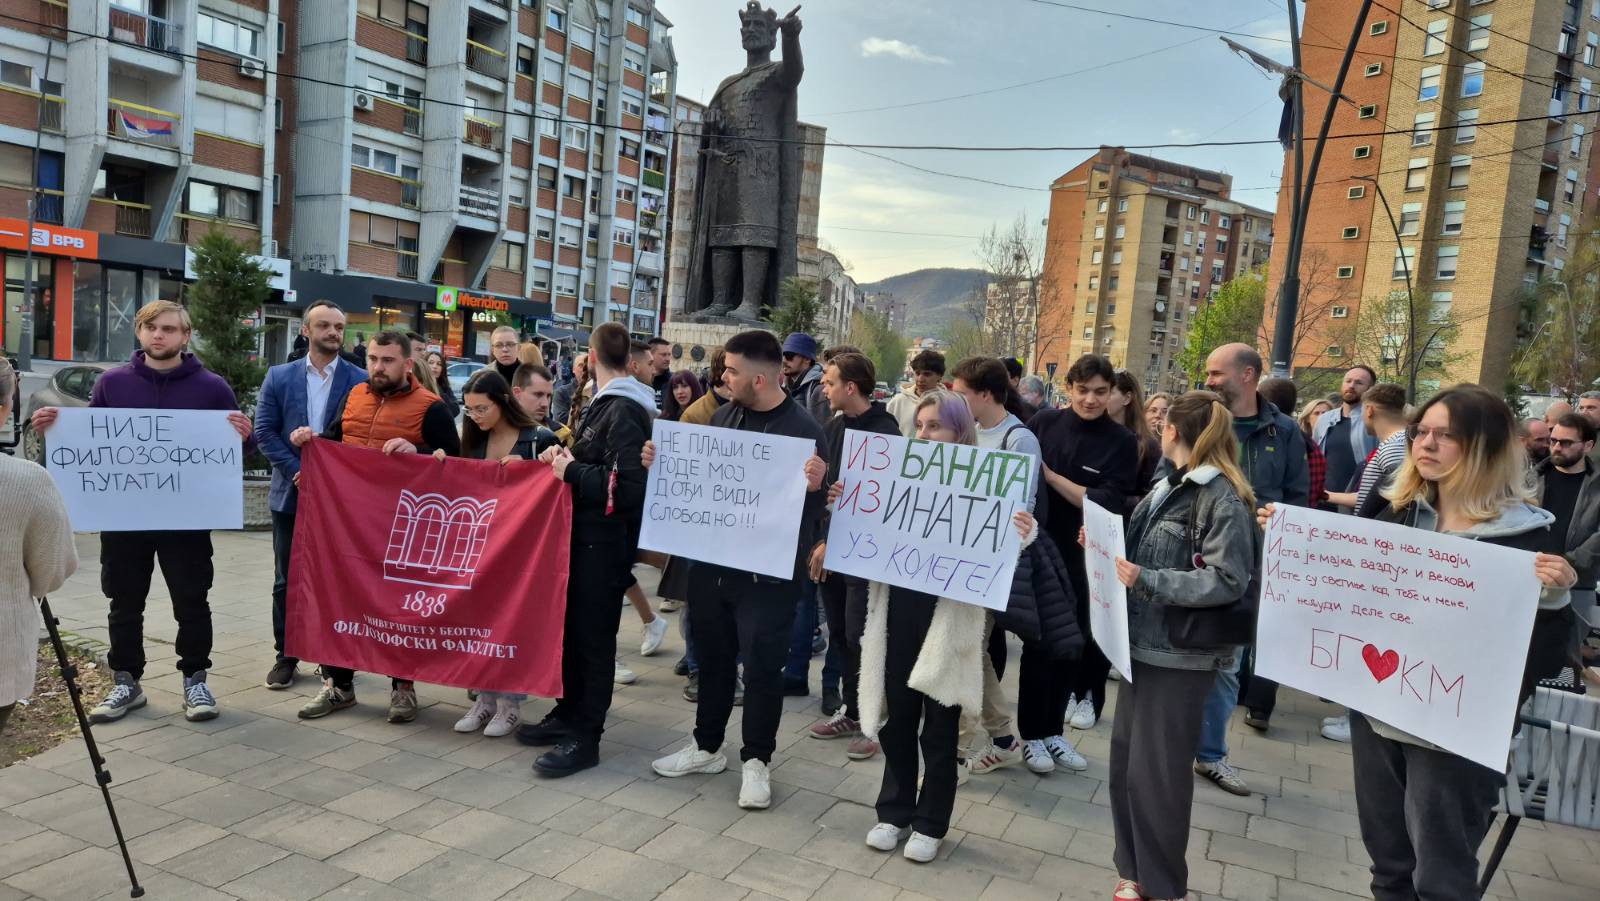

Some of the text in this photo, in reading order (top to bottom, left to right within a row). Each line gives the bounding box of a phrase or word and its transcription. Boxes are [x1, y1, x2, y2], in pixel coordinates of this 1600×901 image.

[52, 233, 84, 249] BPB
[458, 292, 509, 311] Meridian
[91, 415, 175, 442] НИЈЕ
[51, 445, 236, 469] ФИЛОЗОФСКИ
[660, 430, 772, 461] НЕ ПЛАШИ СЕ
[658, 454, 745, 482] РОДЕ МОЈ
[848, 433, 1031, 503] ИЗ БАНАТА
[654, 478, 761, 508] ДОЂИ ВИДИ
[838, 477, 1015, 553] ИЗ ИНАТА!
[1270, 508, 1304, 534] Иста
[1307, 523, 1319, 542] је
[1323, 529, 1368, 546] земља
[1400, 543, 1422, 555] нас
[841, 531, 1005, 597] УЗ КОЛЕГЕ!
[1268, 533, 1300, 558] Иста
[1303, 549, 1316, 565] је
[1415, 568, 1423, 578] и
[1267, 556, 1301, 581] Исте
[1305, 574, 1318, 587] су
[1422, 595, 1430, 603] и
[401, 590, 447, 618] 1838
[333, 620, 518, 659] ФИЛОЗОФСКИ ФАКУЛТЕТ
[362, 613, 493, 638] УНИВЕРЗИТЕТ У БЕОГРАДУ
[1311, 628, 1464, 718] БГ КМ
